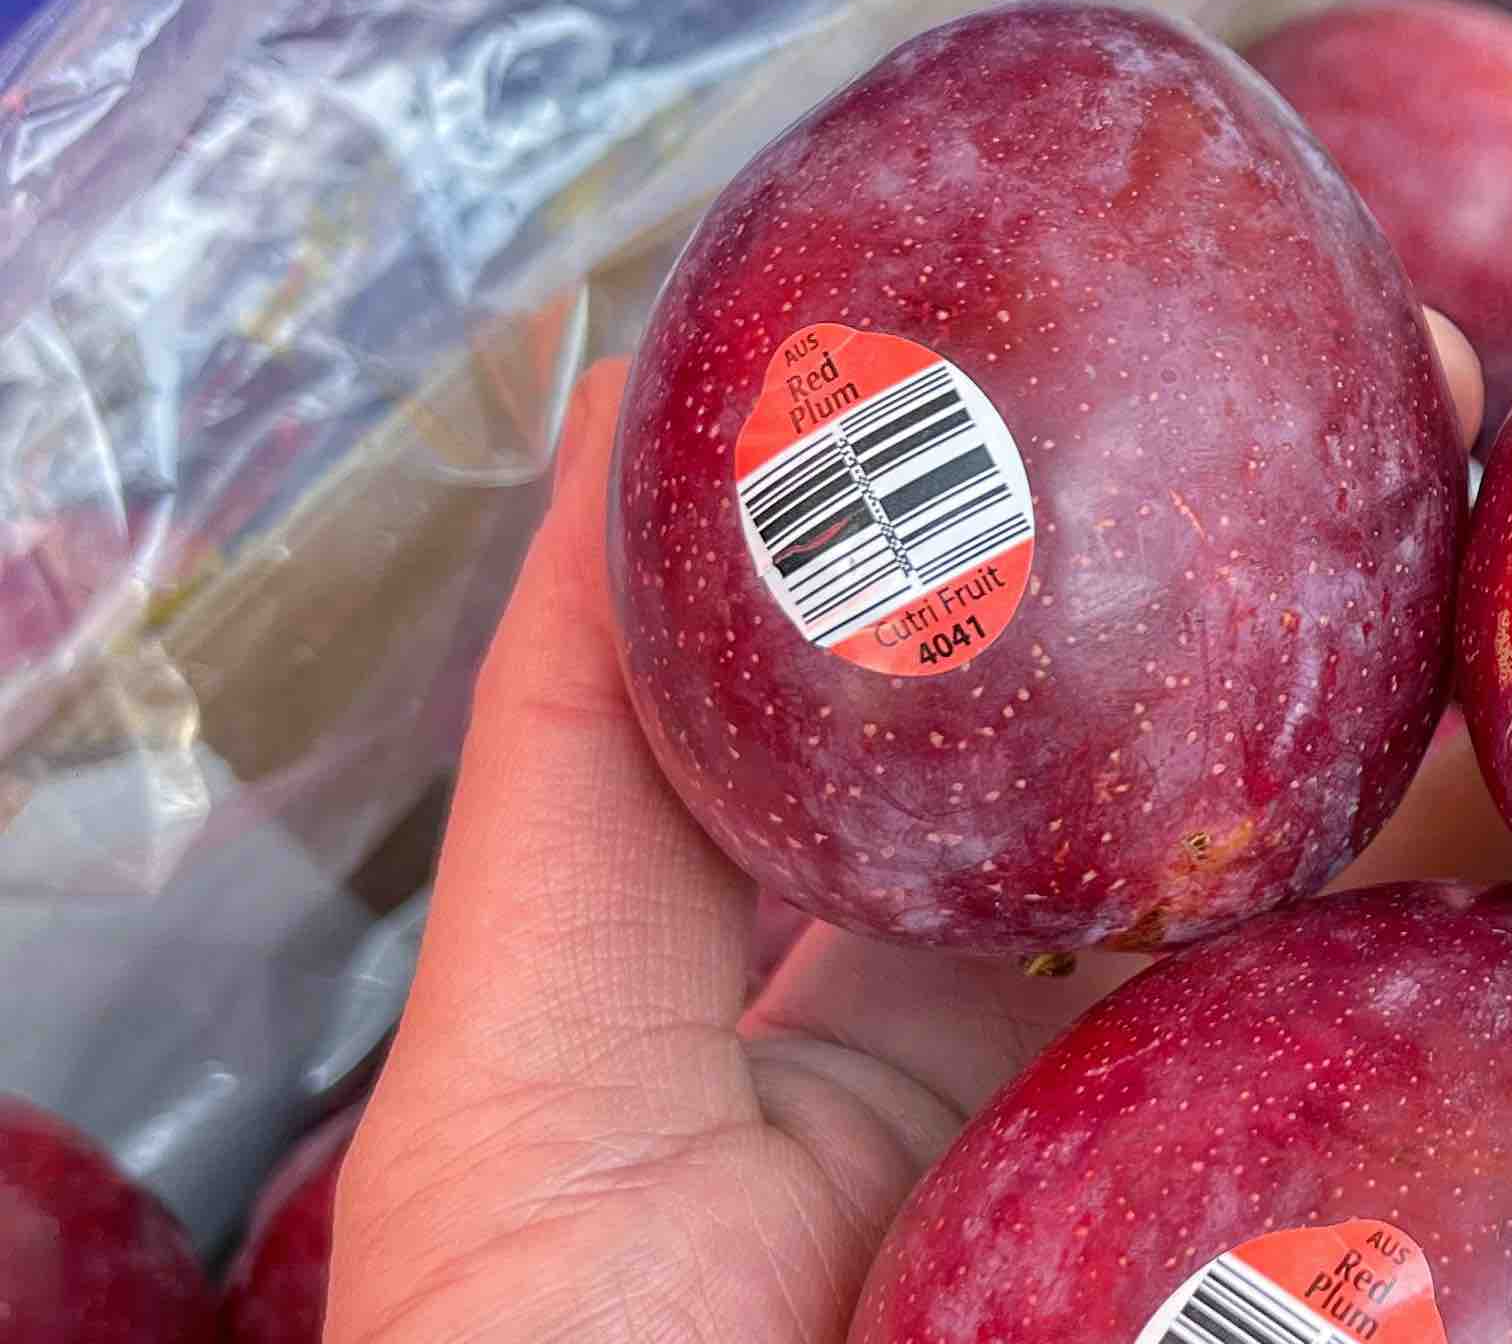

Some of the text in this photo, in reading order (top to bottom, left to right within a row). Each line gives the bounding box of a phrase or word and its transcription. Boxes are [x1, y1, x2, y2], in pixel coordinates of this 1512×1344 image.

[785, 333, 819, 367] AUS
[786, 351, 839, 402] Red
[789, 383, 860, 434] Plum
[875, 566, 1006, 647] Cutri Fruit
[919, 614, 986, 664] 4041
[1366, 1231, 1411, 1265] AUS
[1334, 1248, 1397, 1304] Red
[1304, 1273, 1378, 1340] Plum
